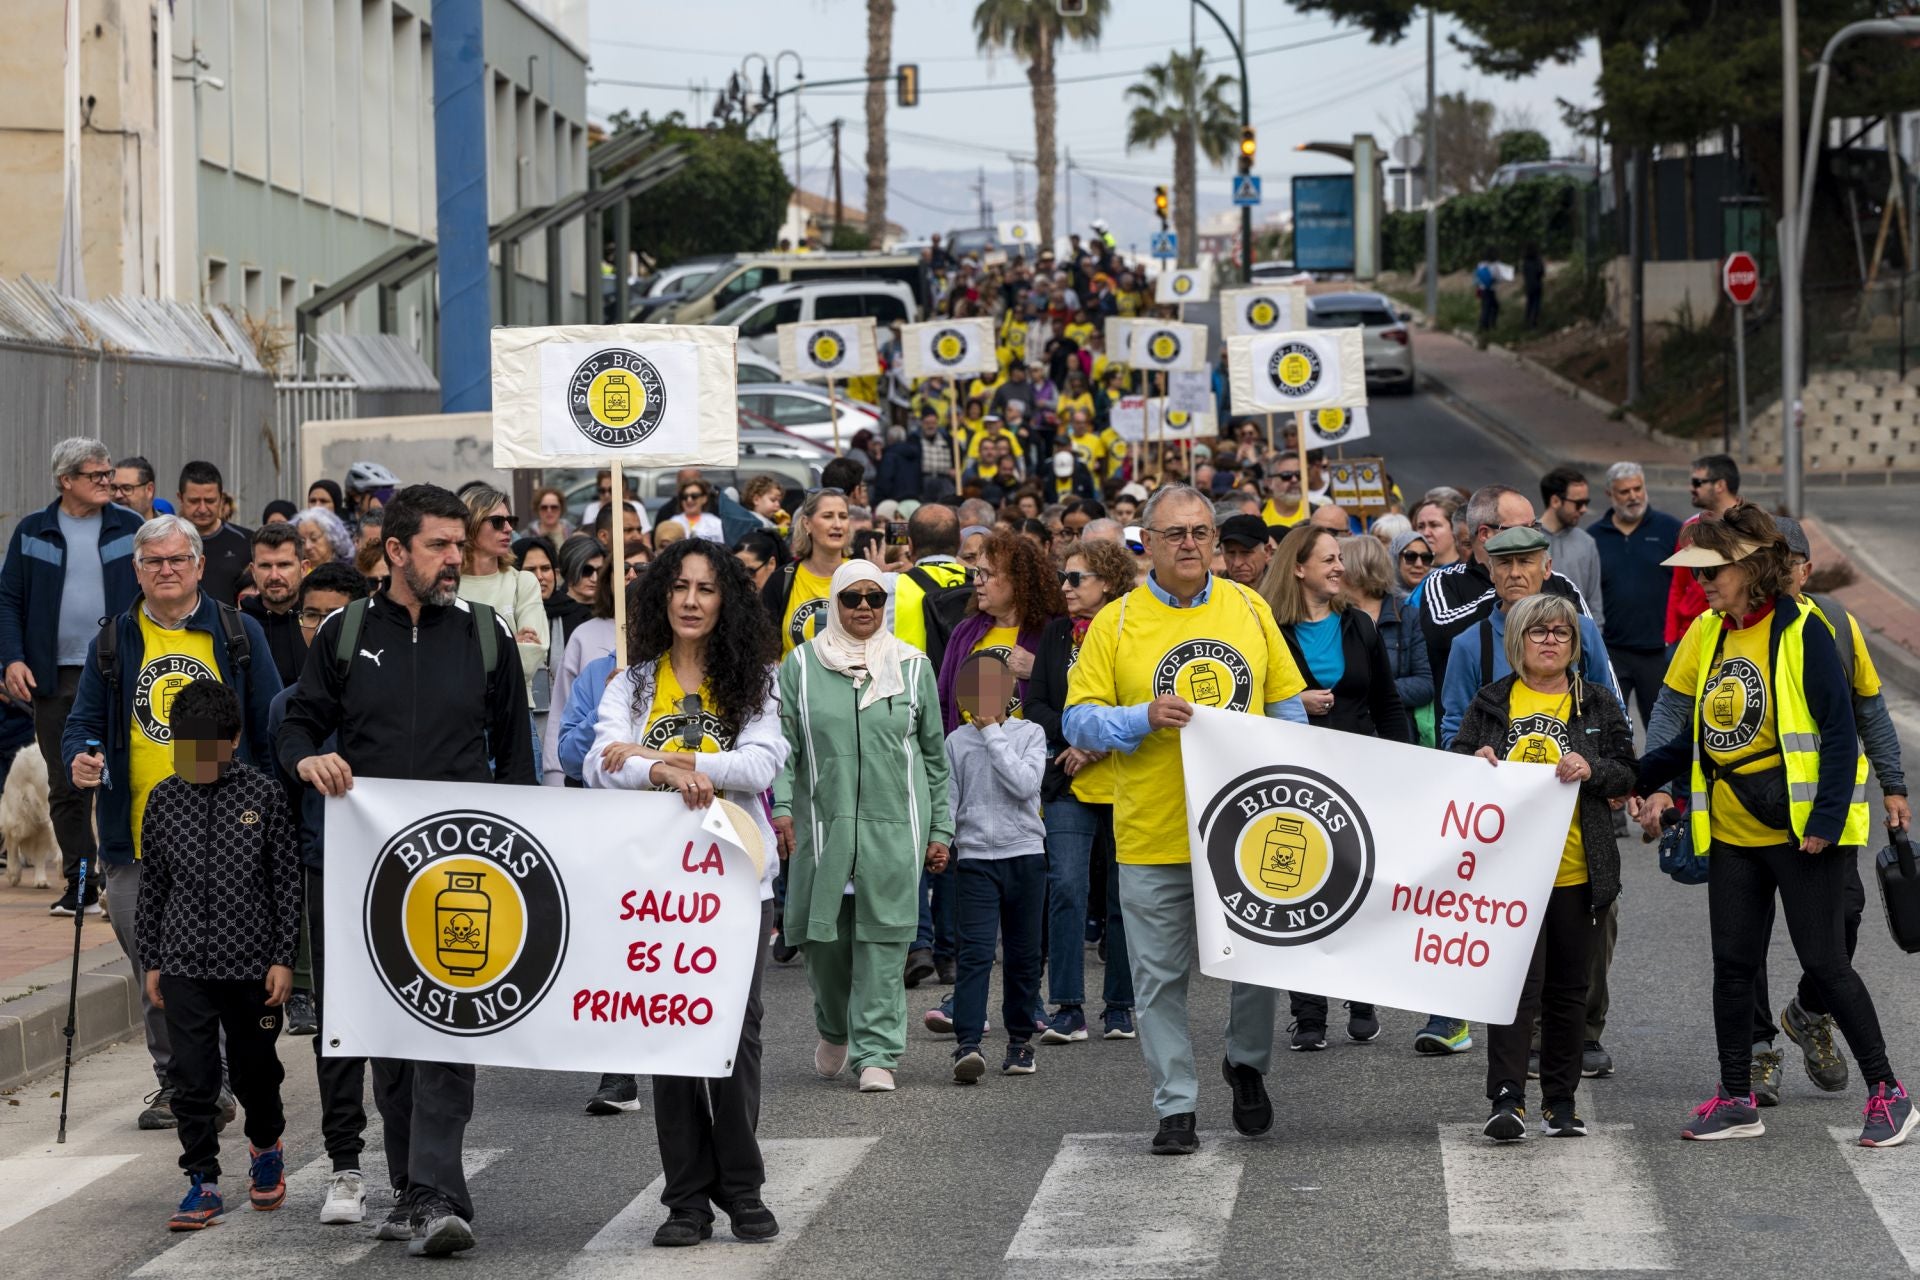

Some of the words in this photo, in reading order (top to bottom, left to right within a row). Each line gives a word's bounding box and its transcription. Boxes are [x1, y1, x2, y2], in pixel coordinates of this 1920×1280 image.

[573, 361, 599, 404] STOP
[585, 418, 653, 442] MOLINA
[793, 605, 813, 632] STOP
[135, 666, 158, 706] STOP
[1160, 655, 1181, 695] STOP
[642, 721, 676, 751] TOP
[1237, 785, 1348, 833] BIOGÁS
[1440, 799, 1505, 844] NO
[394, 823, 540, 879] BIOGÁS
[681, 840, 725, 876] LA
[1457, 850, 1476, 882] a
[619, 889, 721, 924] SALUD
[1223, 891, 1276, 927] ASÍ
[1286, 901, 1329, 928] NO
[1391, 883, 1528, 928] nuestro
[626, 940, 663, 973] ES
[673, 942, 717, 974] LO
[1414, 927, 1490, 968] lado
[399, 974, 458, 1024] ASÍ
[471, 982, 522, 1025] NO
[573, 988, 714, 1028] PRIMERO
